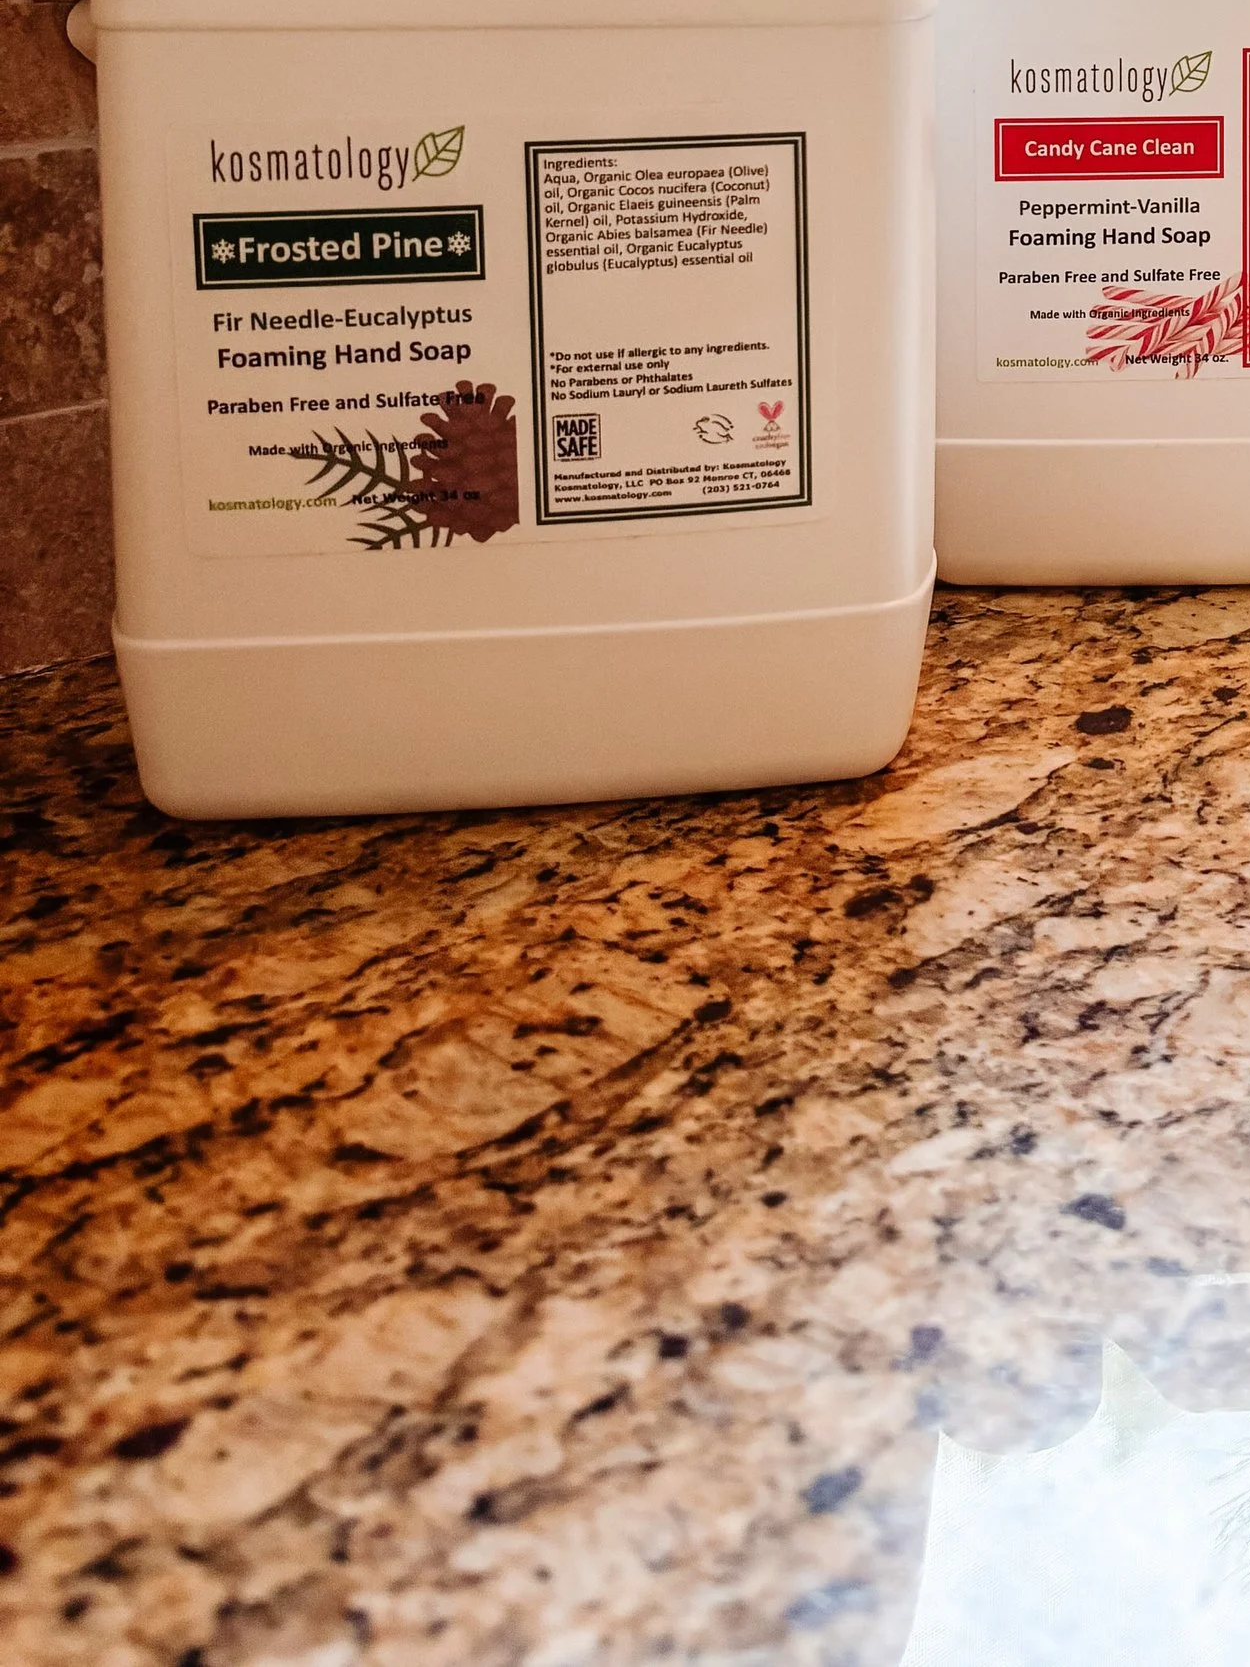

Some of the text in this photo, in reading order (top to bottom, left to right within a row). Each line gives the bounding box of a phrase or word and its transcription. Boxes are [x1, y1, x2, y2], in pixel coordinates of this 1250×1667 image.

[1011, 58, 1167, 103] kosmatology
[1025, 139, 1194, 159] Candy Cane Clean
[211, 137, 409, 190] kosmatology
[544, 157, 617, 172] Ingredients:
[544, 166, 768, 187] Aqua, Organic Olea europaea (Olive)
[545, 181, 769, 201] oil, Organic Cocos nucifera (Coconut)
[545, 194, 760, 215] oil, Organic Elaeis guineensis (Palm
[1019, 197, 1200, 219] Peppermint-Vanilla
[546, 211, 747, 231] Kernel) oil, Potassium Hydroxide,
[546, 224, 767, 245] Organic Abies balsamea (Fir Needle)
[1009, 227, 1210, 248] Foaming Hand Soap
[239, 233, 443, 263] Frosted Pine
[547, 239, 742, 257] essential oil, Organic Eucalyptus
[547, 253, 752, 274] globulus (Eucalyptus) essential oil
[999, 269, 1220, 283] Paraben Free and Sulfate Free
[214, 305, 472, 332] Fir Needle-Eucalyptus
[1030, 308, 1190, 320] Made with Organic Ingredients
[218, 341, 471, 370] Foaming Hand Soap
[997, 353, 1229, 368] kosmatology.com Net Weight 34 oz.
[551, 378, 566, 388] No
[570, 376, 618, 386] Parabens
[636, 372, 693, 382] Phthalates
[552, 391, 566, 401] No
[570, 389, 609, 399] Sodium
[613, 387, 646, 399] Lauryl
[664, 383, 703, 393] Sodium
[707, 381, 747, 391] Laureth
[751, 378, 792, 388] Sulfates
[208, 391, 485, 414] Paraben Free and Sulfate Free
[557, 418, 597, 436] MADE
[249, 445, 285, 455] Made
[289, 443, 318, 454] with
[557, 437, 597, 457] SAFE
[209, 496, 336, 511] kosmatology.com
[353, 494, 378, 504] Net
